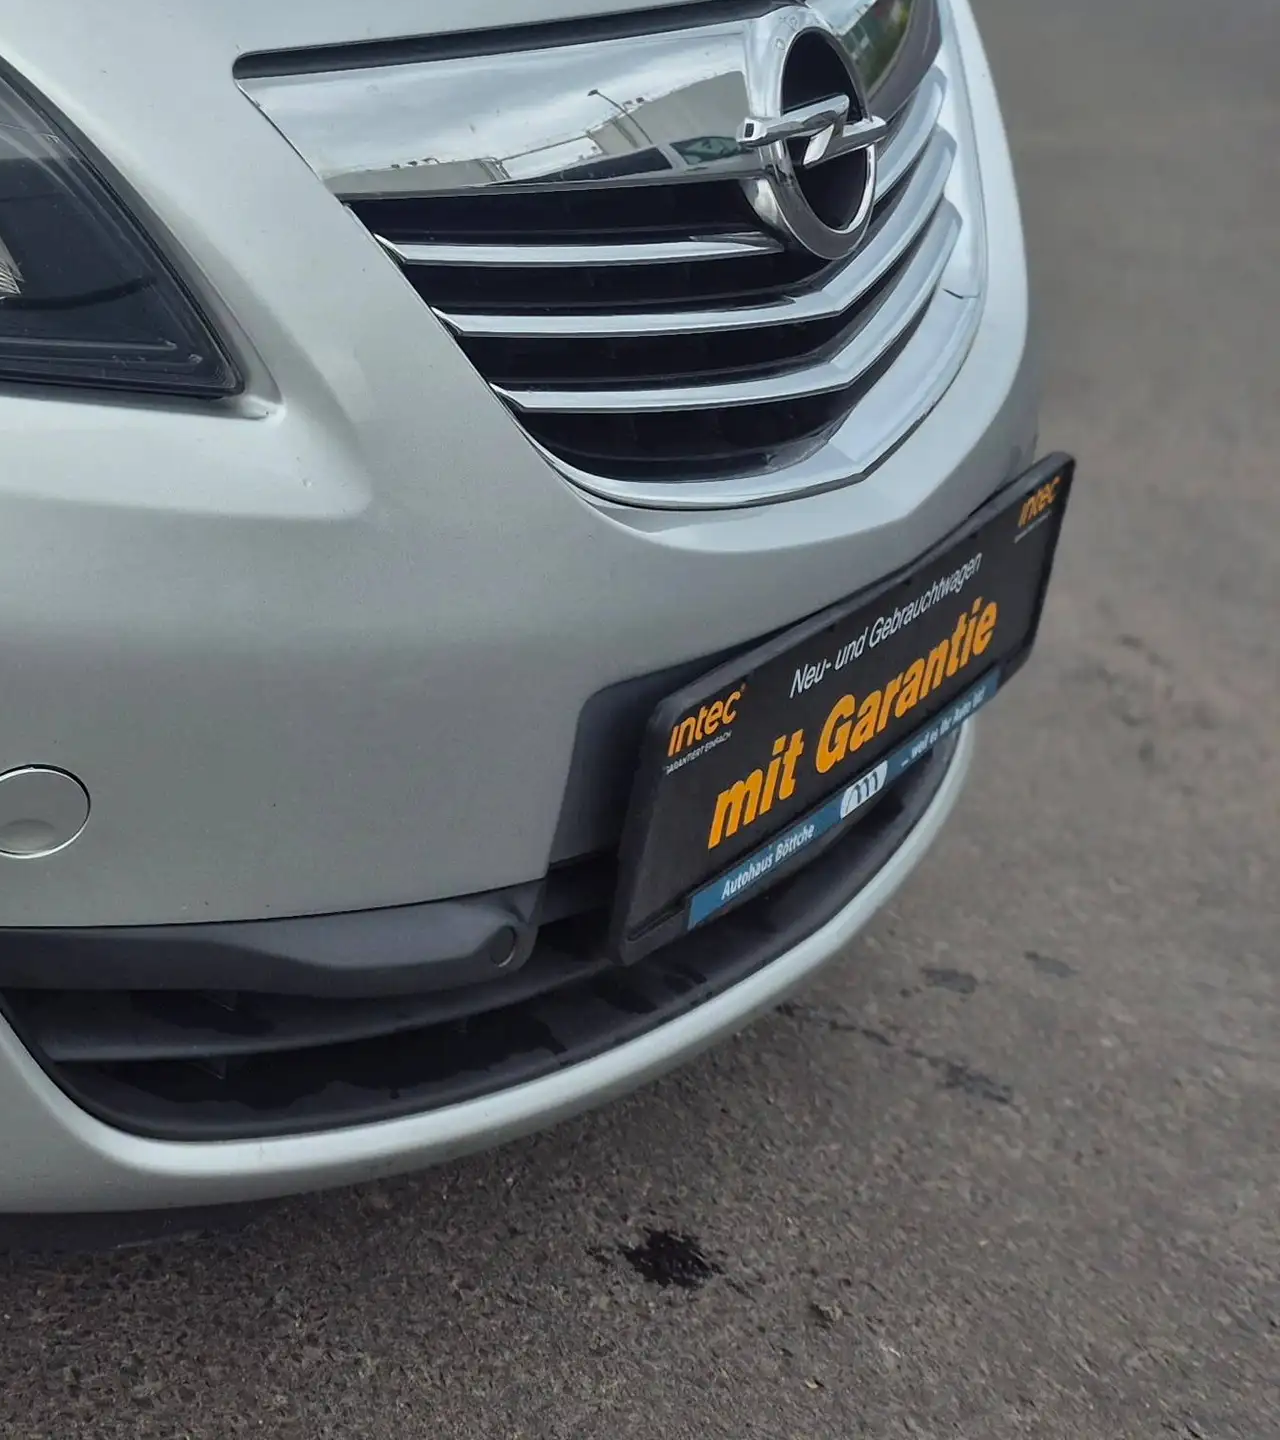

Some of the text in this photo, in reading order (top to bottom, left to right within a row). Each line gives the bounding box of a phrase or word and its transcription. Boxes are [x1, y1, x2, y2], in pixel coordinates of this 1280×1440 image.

[789, 552, 983, 699] Neu- und Gebrauchtwagen
[707, 596, 998, 850] mit Garantie
[721, 853, 774, 901] Autohaus
